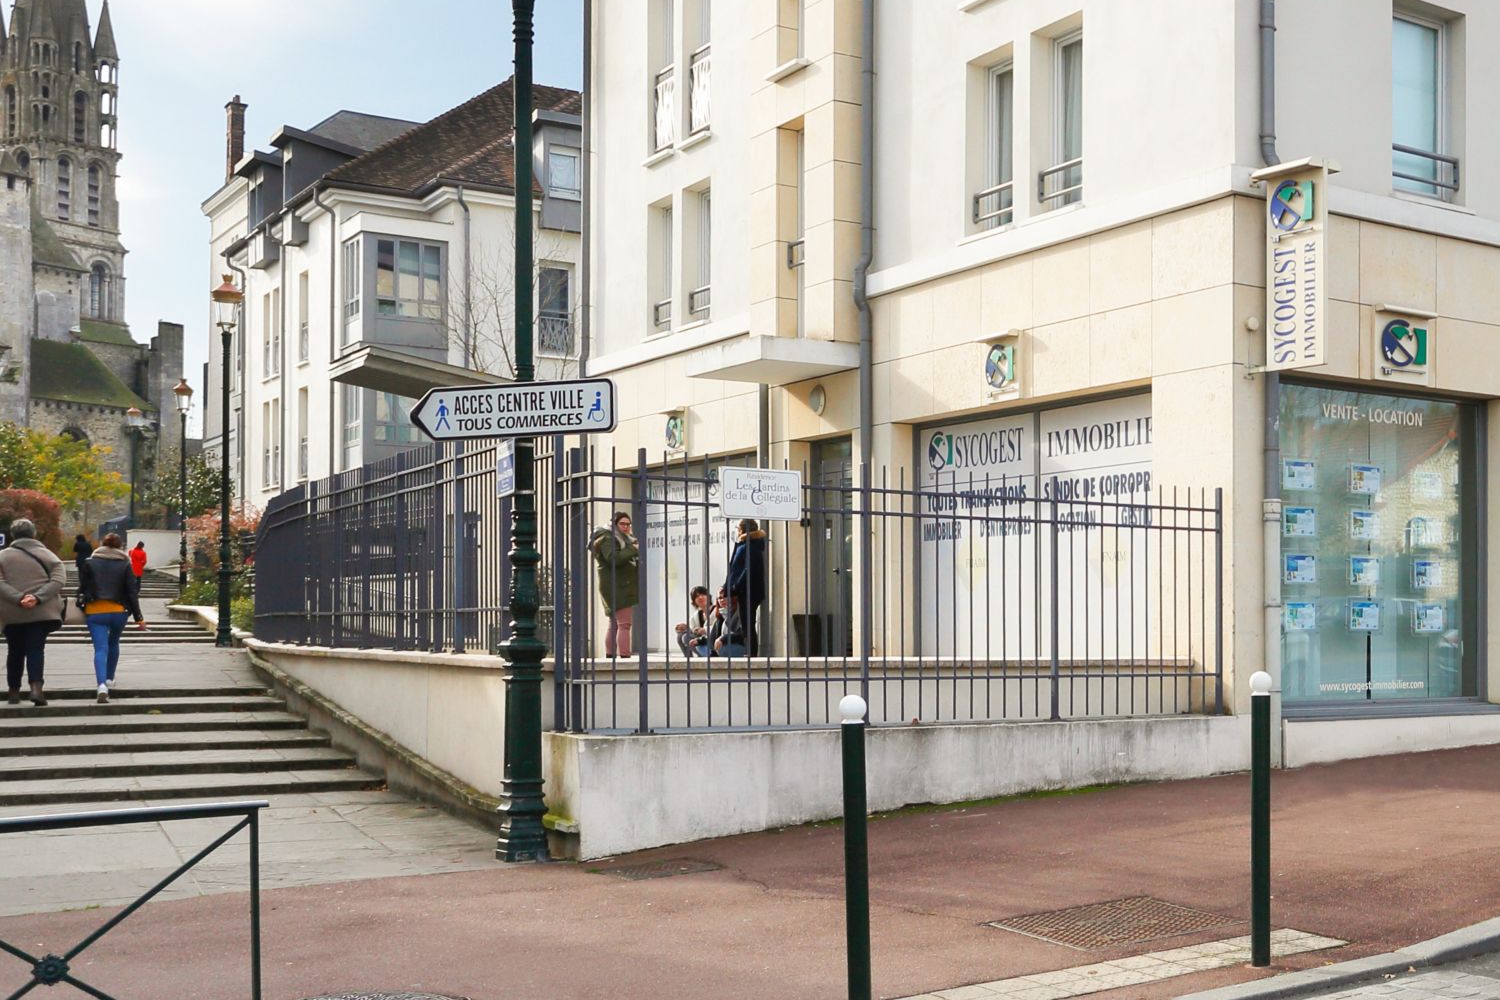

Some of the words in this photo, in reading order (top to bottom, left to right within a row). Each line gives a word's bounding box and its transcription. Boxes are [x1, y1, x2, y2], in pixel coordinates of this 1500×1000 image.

[1273, 246, 1297, 365] SYCOGEST
[1303, 240, 1316, 360] IMMOBILIER
[454, 392, 493, 416] ACCES
[497, 390, 546, 413] CENTRE
[549, 388, 584, 410] VILLE
[1322, 403, 1359, 421] VENTE
[1368, 408, 1423, 427] LOCATION
[456, 416, 492, 432] TOUS
[496, 412, 583, 430] COMMERCES
[954, 427, 1025, 469] SYCOGEST
[725, 490, 738, 500] de
[740, 490, 748, 500] la
[736, 477, 753, 490] Les
[752, 479, 791, 493] Jardins
